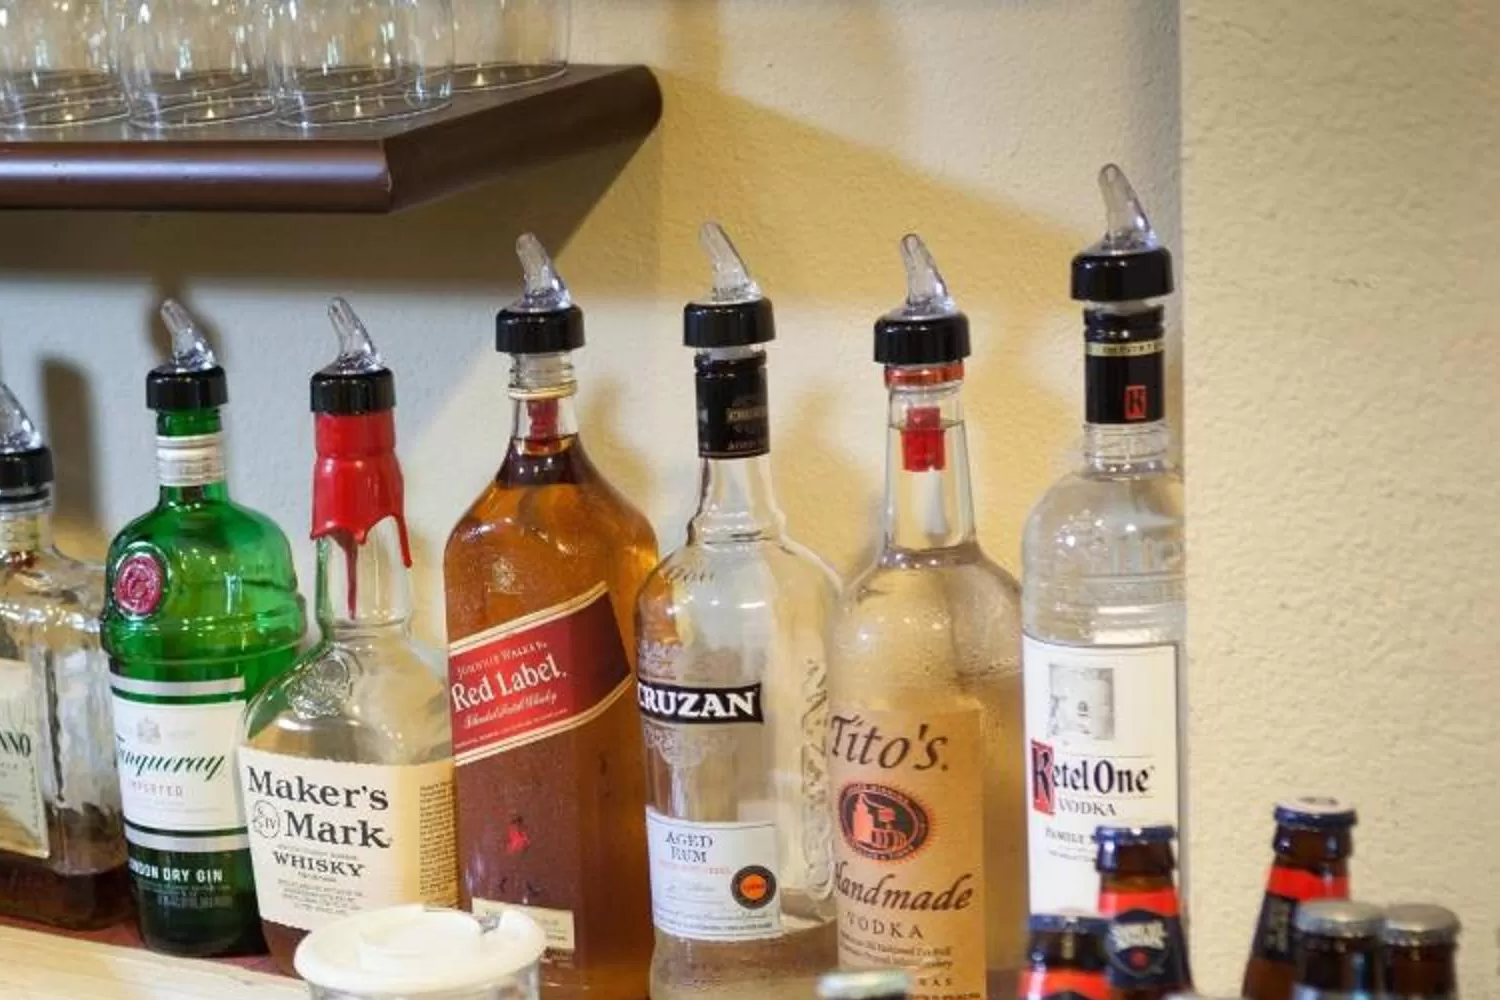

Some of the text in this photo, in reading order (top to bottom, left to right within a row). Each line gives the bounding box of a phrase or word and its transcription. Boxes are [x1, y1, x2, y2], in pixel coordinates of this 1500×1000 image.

[451, 671, 495, 713] Red
[638, 682, 755, 718] CRUZAN
[247, 765, 389, 811] Maker's
[1031, 746, 1150, 803] Ketel One
[284, 809, 392, 849] Mark
[665, 831, 715, 849] AGED
[273, 851, 366, 878] WHISKY
[671, 845, 708, 864] RUM
[163, 867, 191, 883] DRY
[196, 868, 223, 884] GIN
[834, 860, 974, 912] Handmade
[846, 911, 924, 939] VODKA
